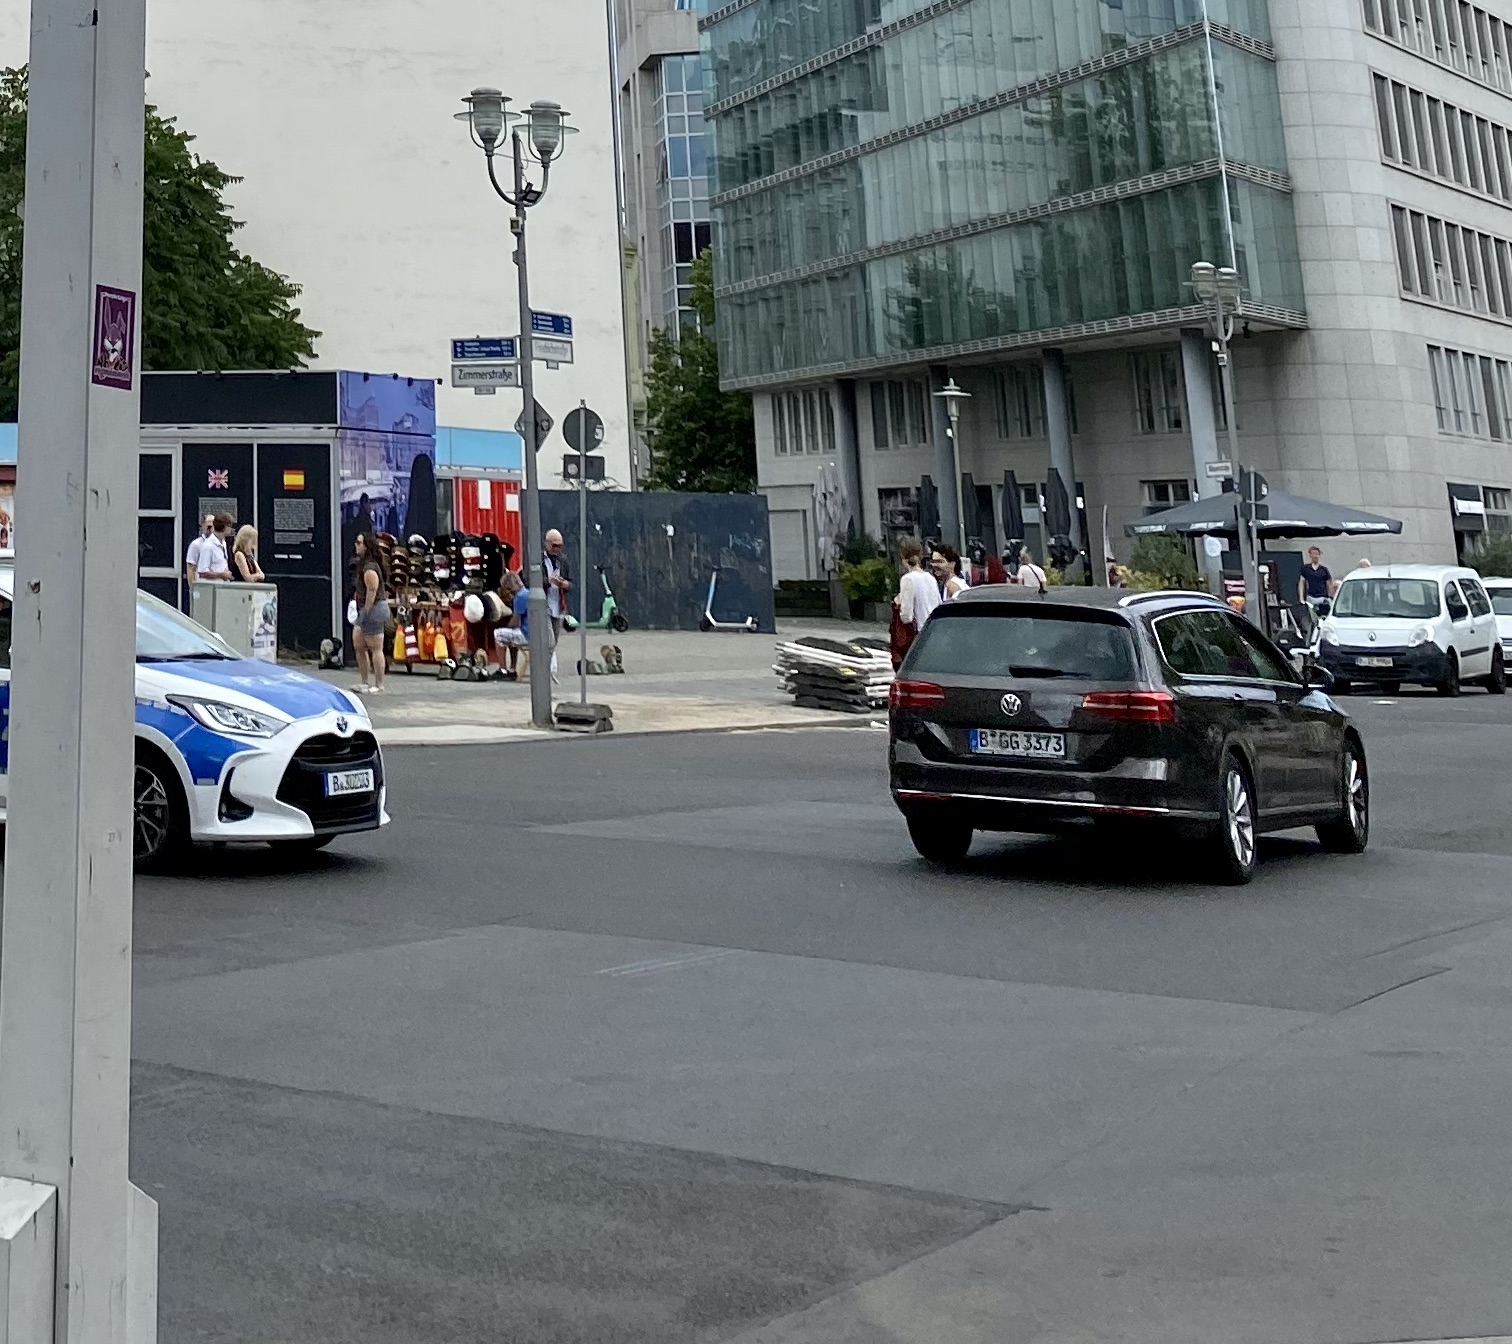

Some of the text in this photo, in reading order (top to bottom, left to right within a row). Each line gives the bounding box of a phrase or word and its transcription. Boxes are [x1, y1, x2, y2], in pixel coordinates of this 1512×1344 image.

[458, 368, 513, 382] Zimmerstraße
[979, 731, 1063, 753] B GG 3373
